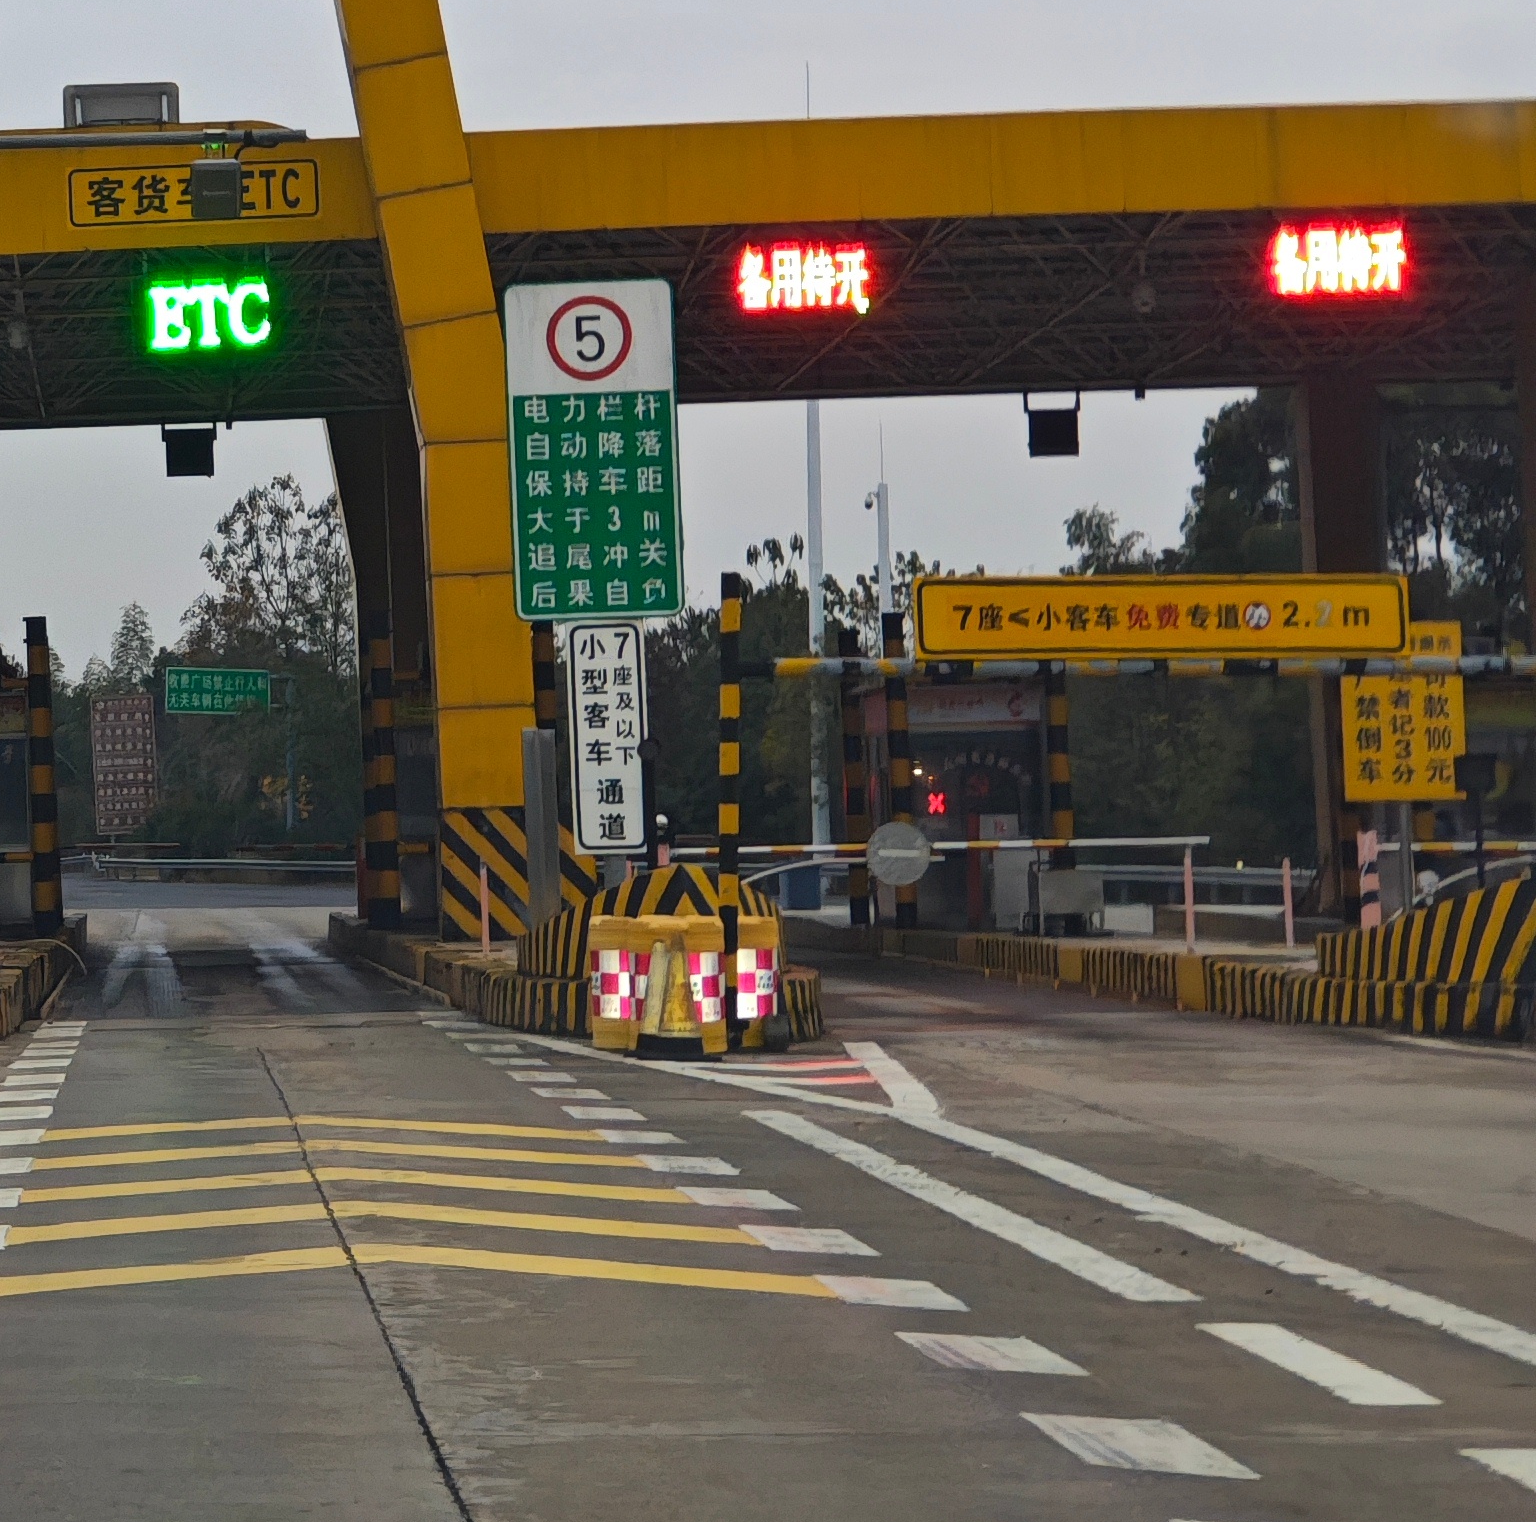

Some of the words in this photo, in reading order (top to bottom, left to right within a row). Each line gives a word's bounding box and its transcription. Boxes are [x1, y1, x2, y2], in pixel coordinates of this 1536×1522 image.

[239, 167, 301, 212] ETC
[148, 278, 272, 351] ETC
[574, 314, 606, 363] 5
[524, 392, 662, 424] 电力栏杆
[525, 429, 663, 461] 自动降落
[525, 465, 665, 498] 保持车距
[526, 504, 661, 535] 大于3m
[527, 537, 668, 572] 追尾冲关
[530, 577, 667, 609] 后果自负
[612, 631, 636, 766] 7座及以下
[1353, 675, 1382, 785] 禁倒车
[1388, 675, 1416, 785] 者记3分
